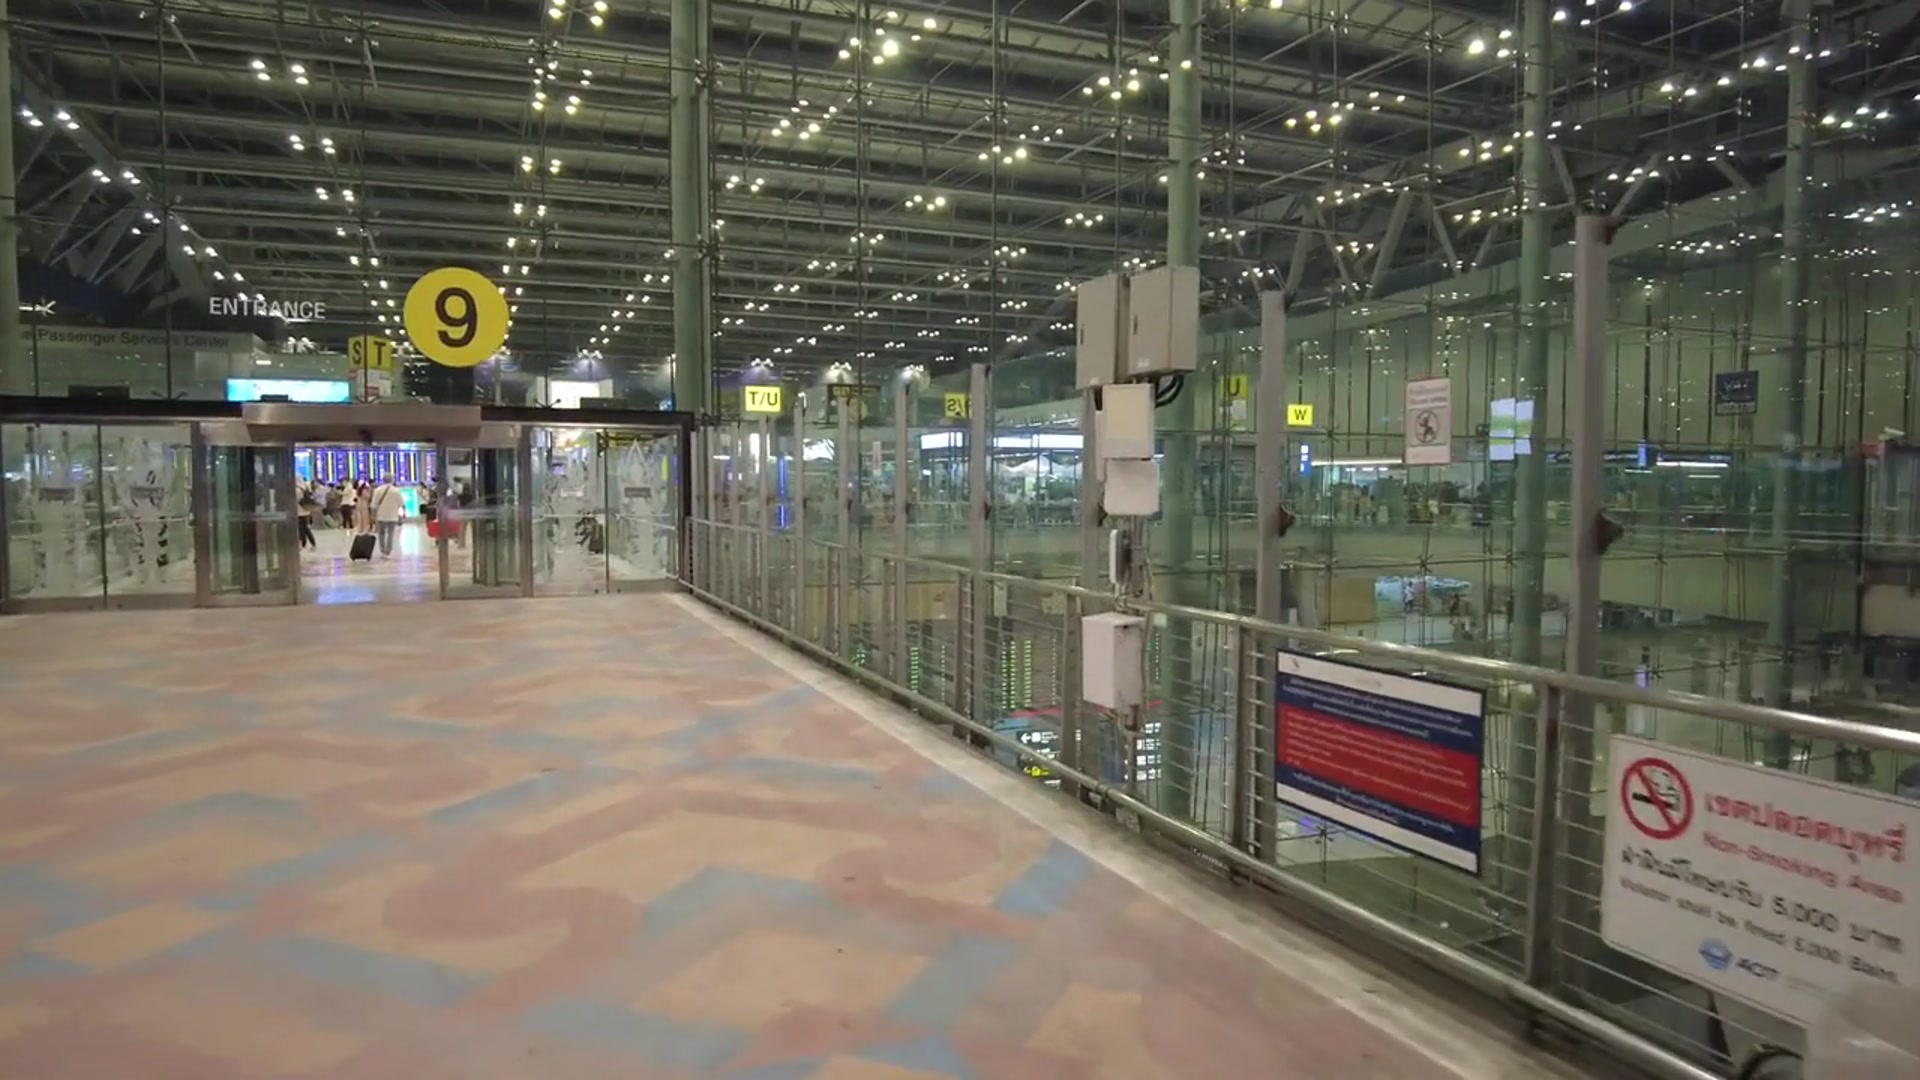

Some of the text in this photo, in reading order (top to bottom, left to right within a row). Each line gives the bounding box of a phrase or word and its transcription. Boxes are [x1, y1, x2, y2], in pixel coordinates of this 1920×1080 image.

[209, 297, 326, 320] ENTRANCE
[434, 287, 477, 348] 9
[38, 328, 116, 346] Passenger
[352, 340, 362, 365] S
[374, 340, 386, 365] T
[748, 390, 779, 407] T/U
[1227, 377, 1240, 397] U
[1294, 408, 1307, 421] W
[1703, 831, 1838, 889] Non-Smoking
